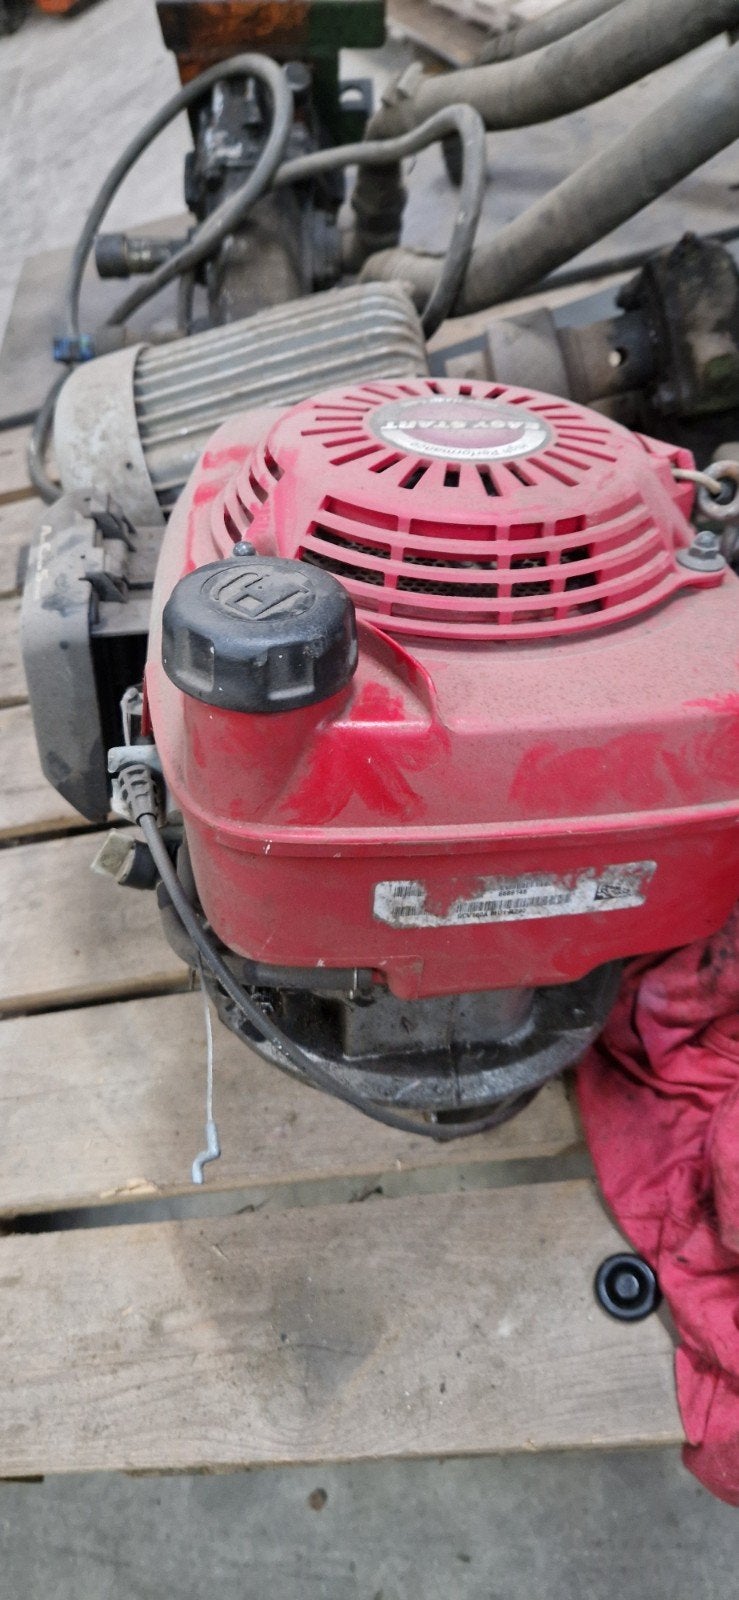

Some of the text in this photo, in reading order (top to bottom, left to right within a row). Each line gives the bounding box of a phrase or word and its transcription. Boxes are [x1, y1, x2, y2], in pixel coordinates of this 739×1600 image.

[381, 419, 541, 431] EASY START
[410, 441, 500, 457] Performance
